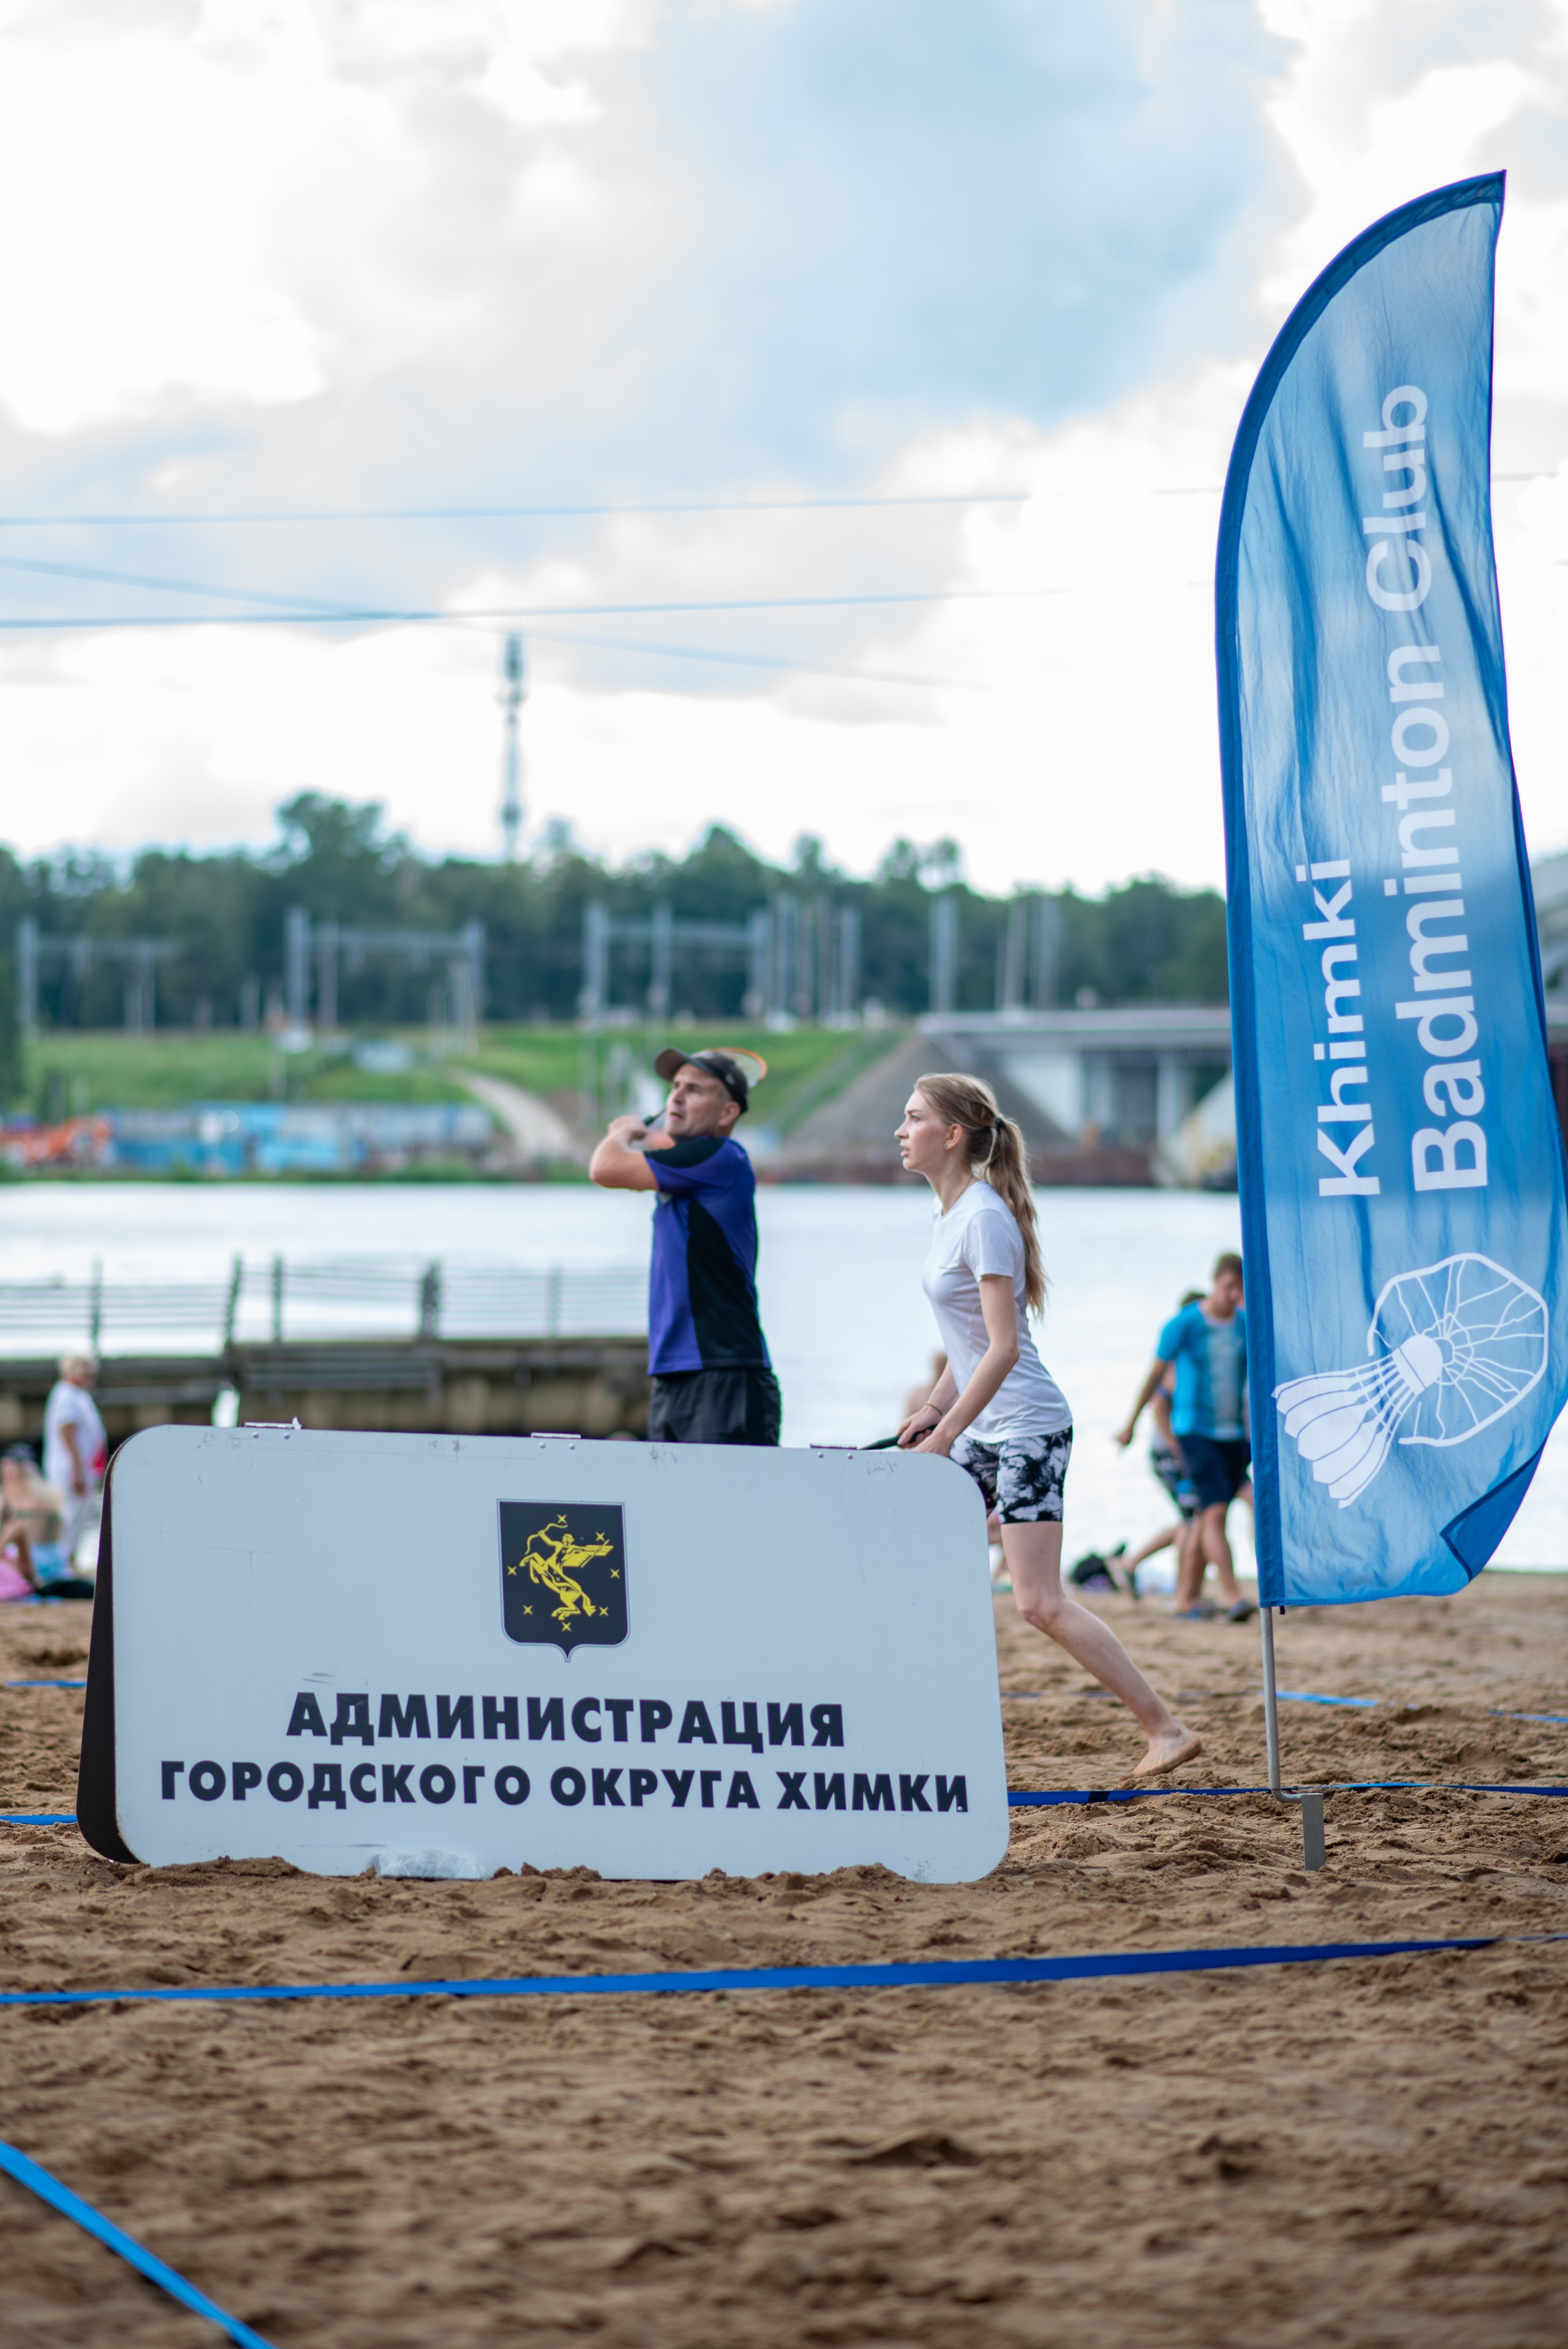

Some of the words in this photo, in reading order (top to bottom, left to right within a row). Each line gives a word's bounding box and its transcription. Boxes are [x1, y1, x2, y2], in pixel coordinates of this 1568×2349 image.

[1362, 383, 1432, 613] Club
[1295, 858, 1381, 1197] Khimki
[1381, 643, 1488, 1192] Badminton
[160, 1760, 531, 1811] ГОРОДСКОГО
[549, 1766, 761, 1809] ОКРУГА
[775, 1771, 970, 1814] ХИМКИ
[285, 1692, 845, 1754] АДМИНИСТРАЦИЯ
